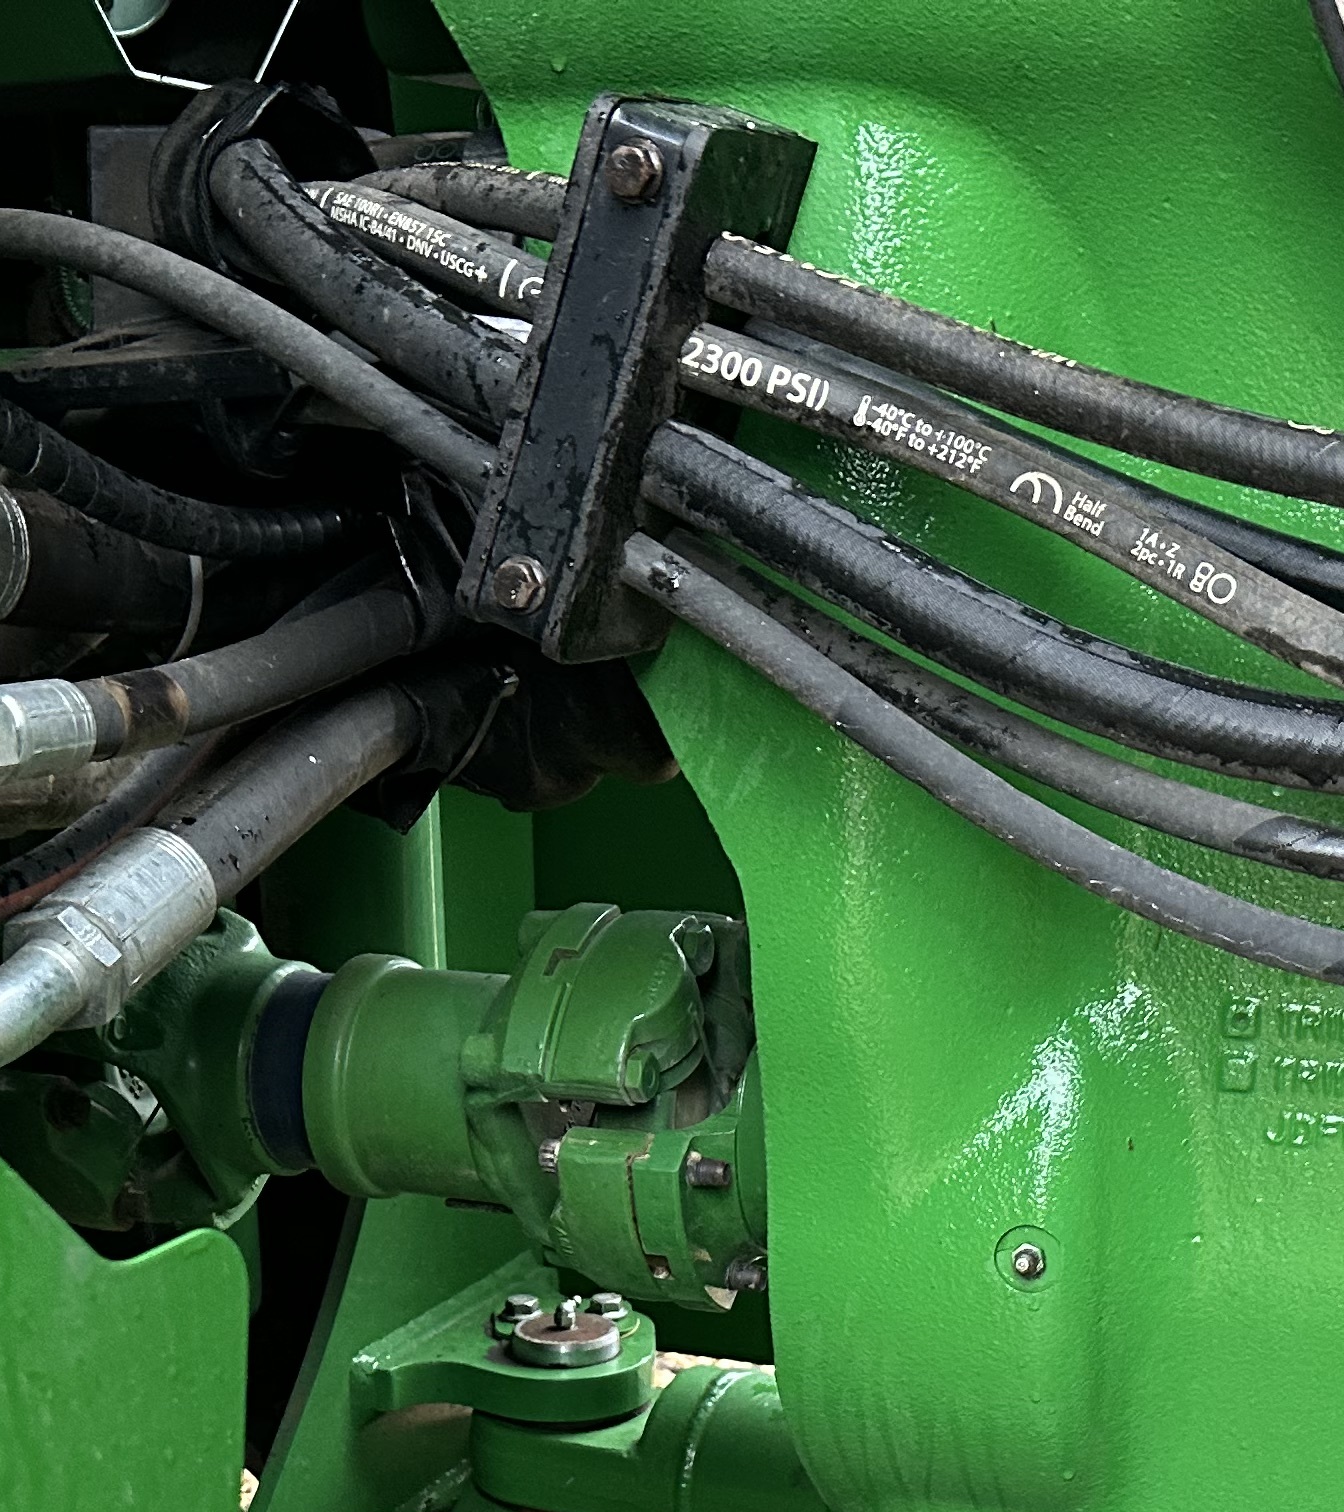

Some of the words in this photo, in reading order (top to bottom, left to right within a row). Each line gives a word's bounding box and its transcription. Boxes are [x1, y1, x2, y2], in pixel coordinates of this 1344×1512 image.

[330, 205, 357, 225] MSHA
[407, 234, 433, 259] DNV
[333, 191, 357, 208] SAE
[356, 196, 385, 219] 100R1
[388, 211, 428, 236] EN857
[427, 226, 452, 247] 1SC
[681, 336, 763, 388] 2300
[766, 363, 830, 412] PSI)
[907, 433, 925, 452] to
[915, 418, 933, 437] to
[1063, 504, 1105, 538] Bend
[1071, 491, 1108, 518] Half
